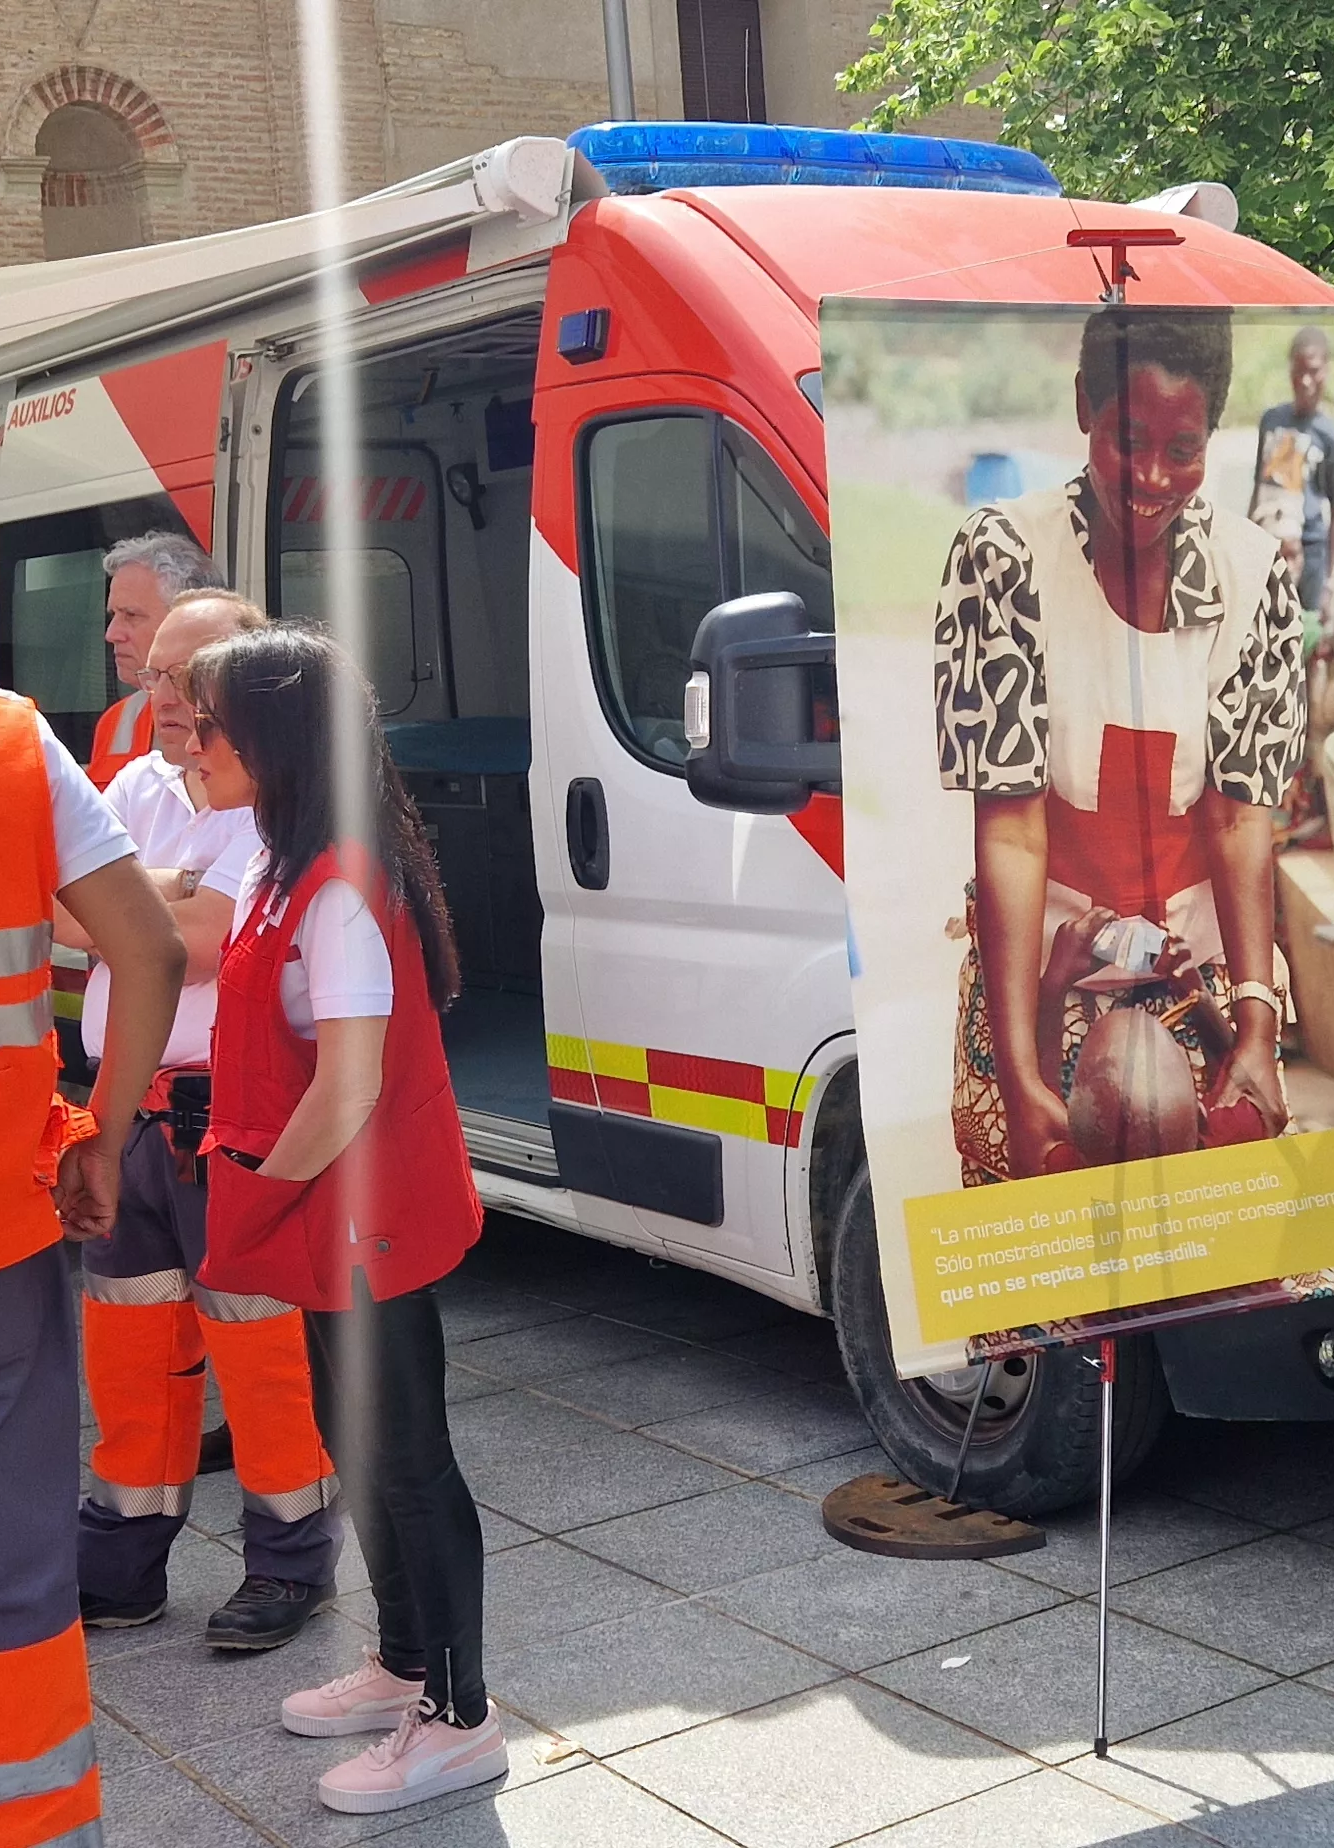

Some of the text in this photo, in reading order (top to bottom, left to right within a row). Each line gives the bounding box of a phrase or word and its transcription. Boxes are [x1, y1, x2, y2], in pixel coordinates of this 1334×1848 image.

[7, 387, 77, 430] AUXILIOS
[963, 1215, 1025, 1240] mirada
[1029, 1211, 1051, 1230] de
[1054, 1208, 1078, 1225] un
[1080, 1200, 1117, 1221] niño
[1120, 1192, 1172, 1213] nunca
[1174, 1178, 1244, 1205] contiene
[1246, 1171, 1284, 1193] odio.
[934, 1253, 974, 1276] Sólo
[976, 1233, 1096, 1269] mostrándoles
[1099, 1228, 1123, 1246] un
[1125, 1216, 1184, 1243] mundo
[1186, 1208, 1234, 1232] mejor
[939, 1284, 975, 1308] que
[978, 1280, 1002, 1298] no
[1004, 1276, 1028, 1293] se
[1030, 1263, 1086, 1289] repita
[1089, 1255, 1130, 1277] esta
